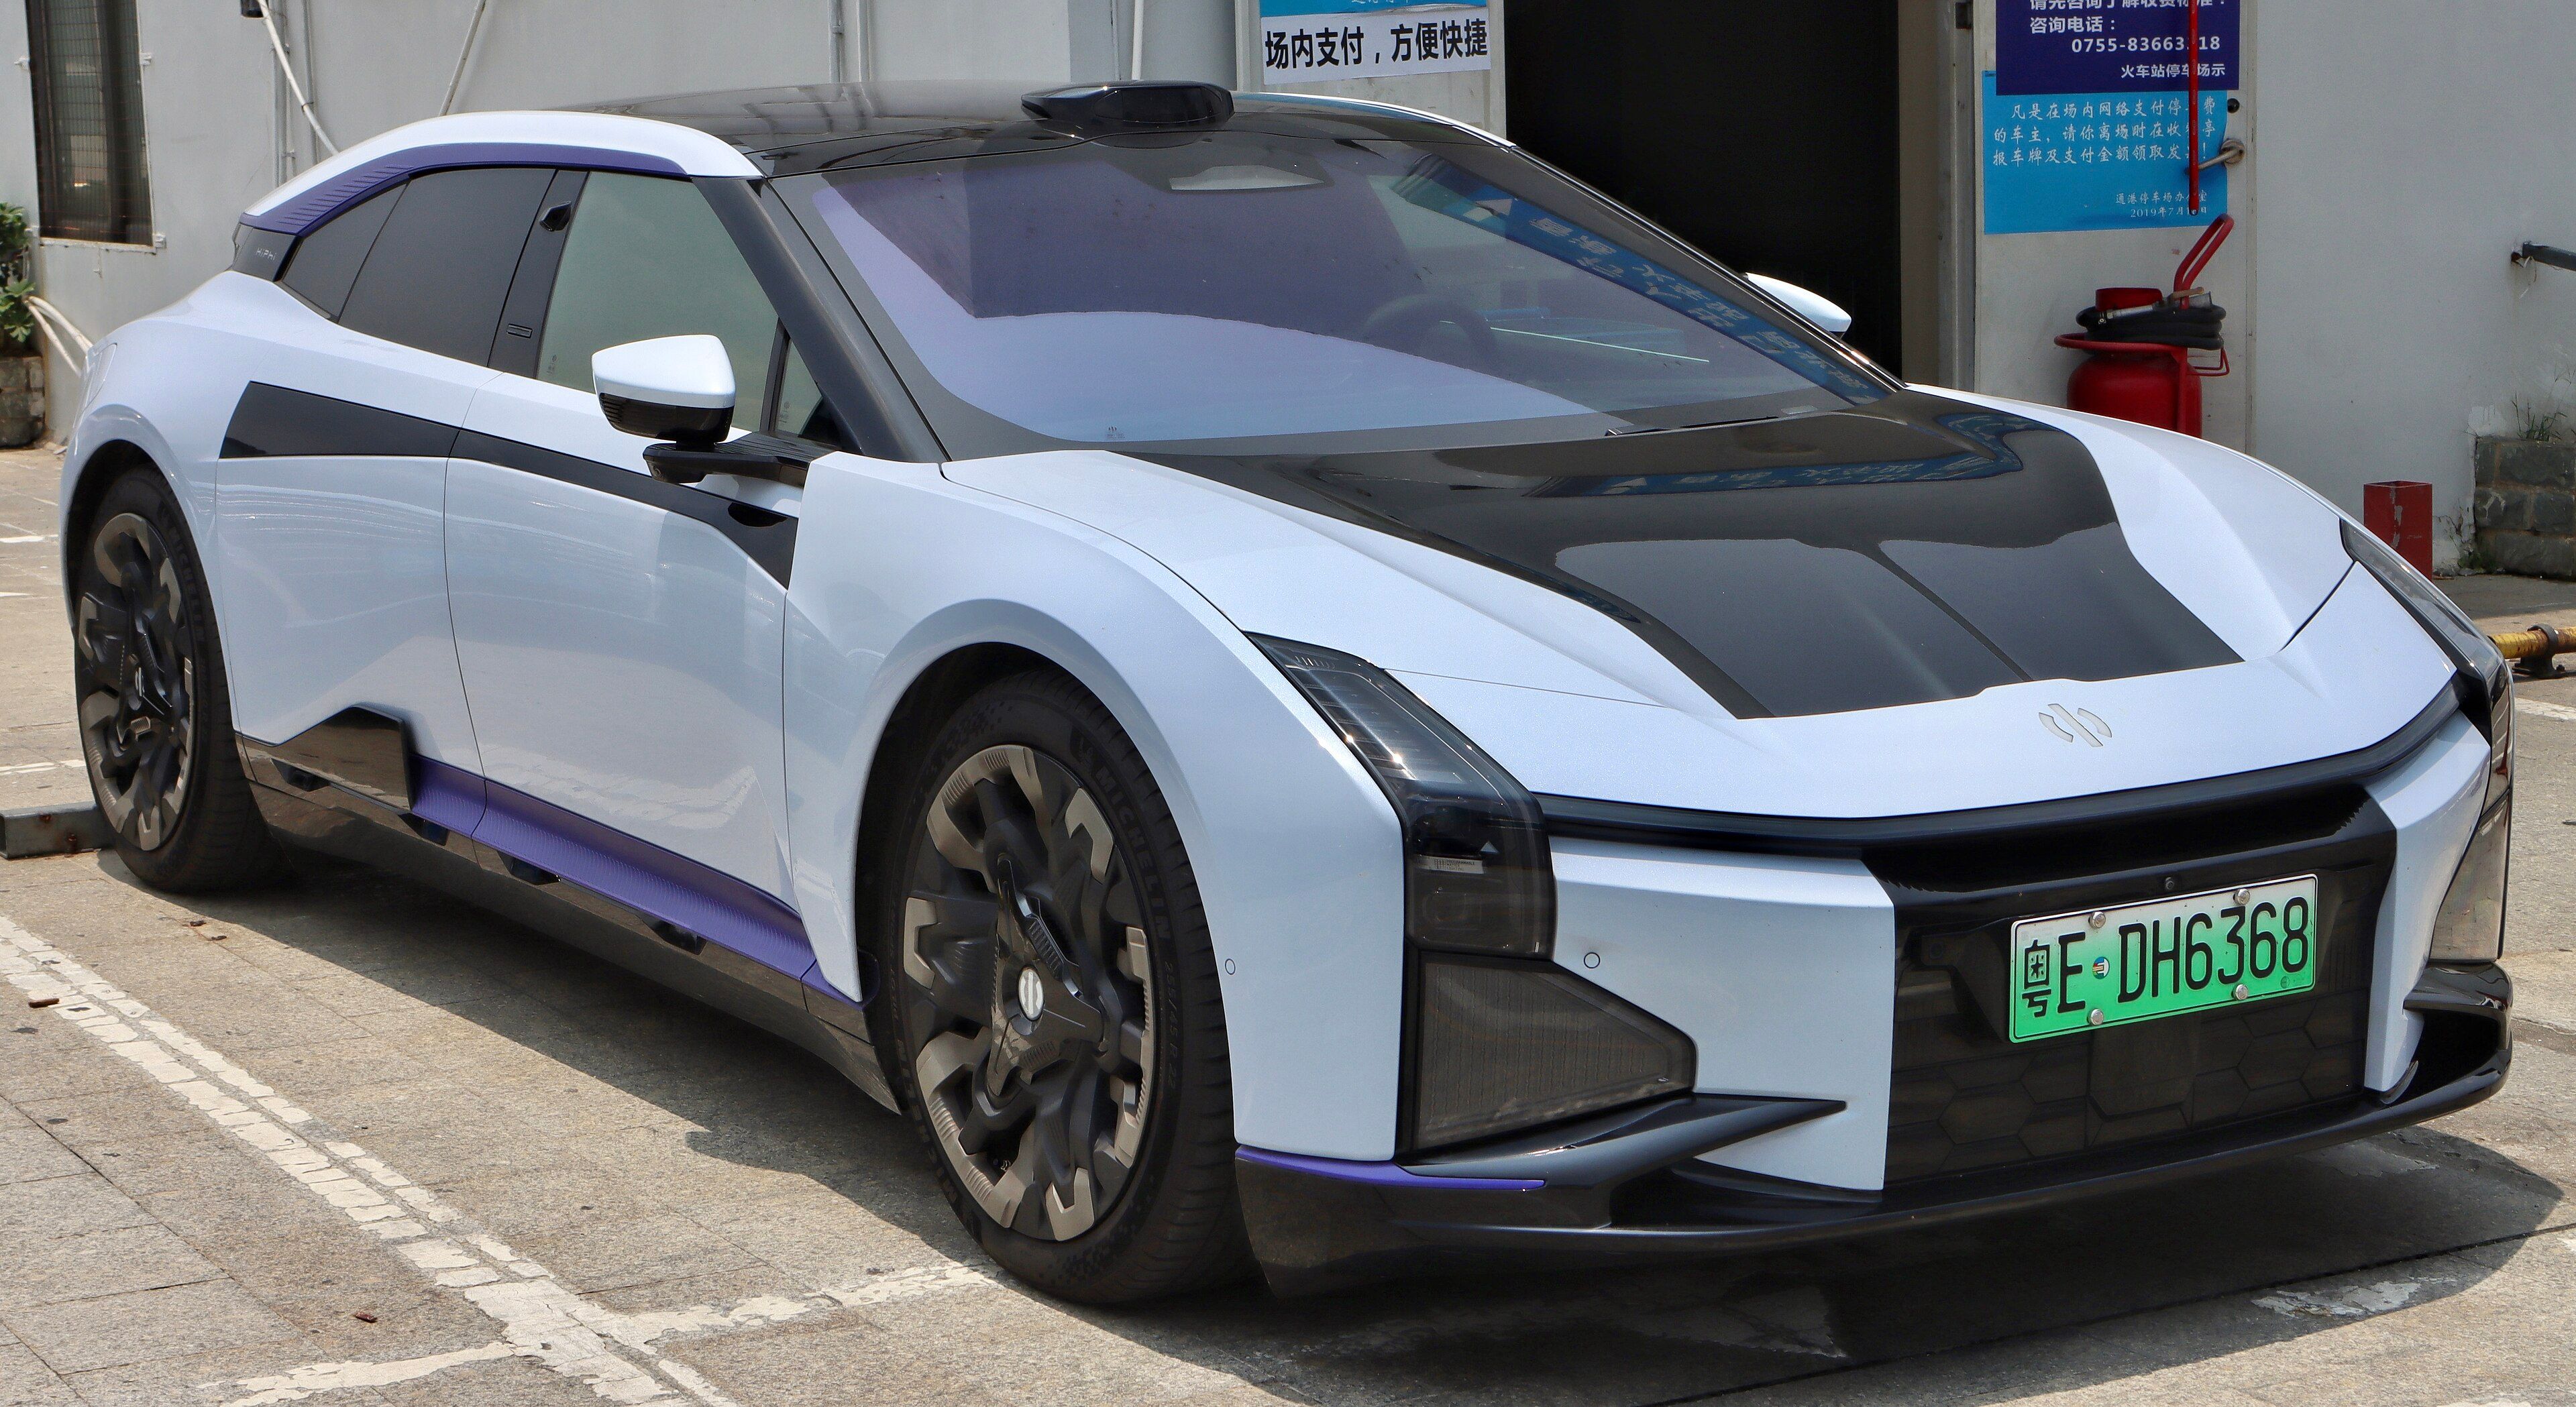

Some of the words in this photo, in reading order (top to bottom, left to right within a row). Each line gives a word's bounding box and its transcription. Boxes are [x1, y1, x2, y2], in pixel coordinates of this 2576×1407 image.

[2030, 16, 2115, 34] 咨询电话：
[1265, 18, 1487, 69] 场内支付，方便快捷
[2072, 36, 2220, 52] 0755-8366318
[2011, 95, 2215, 120] 凡是在场内网络支付停费
[256, 247, 277, 261] HiPhi
[1094, 765, 1171, 940] MICHELIN
